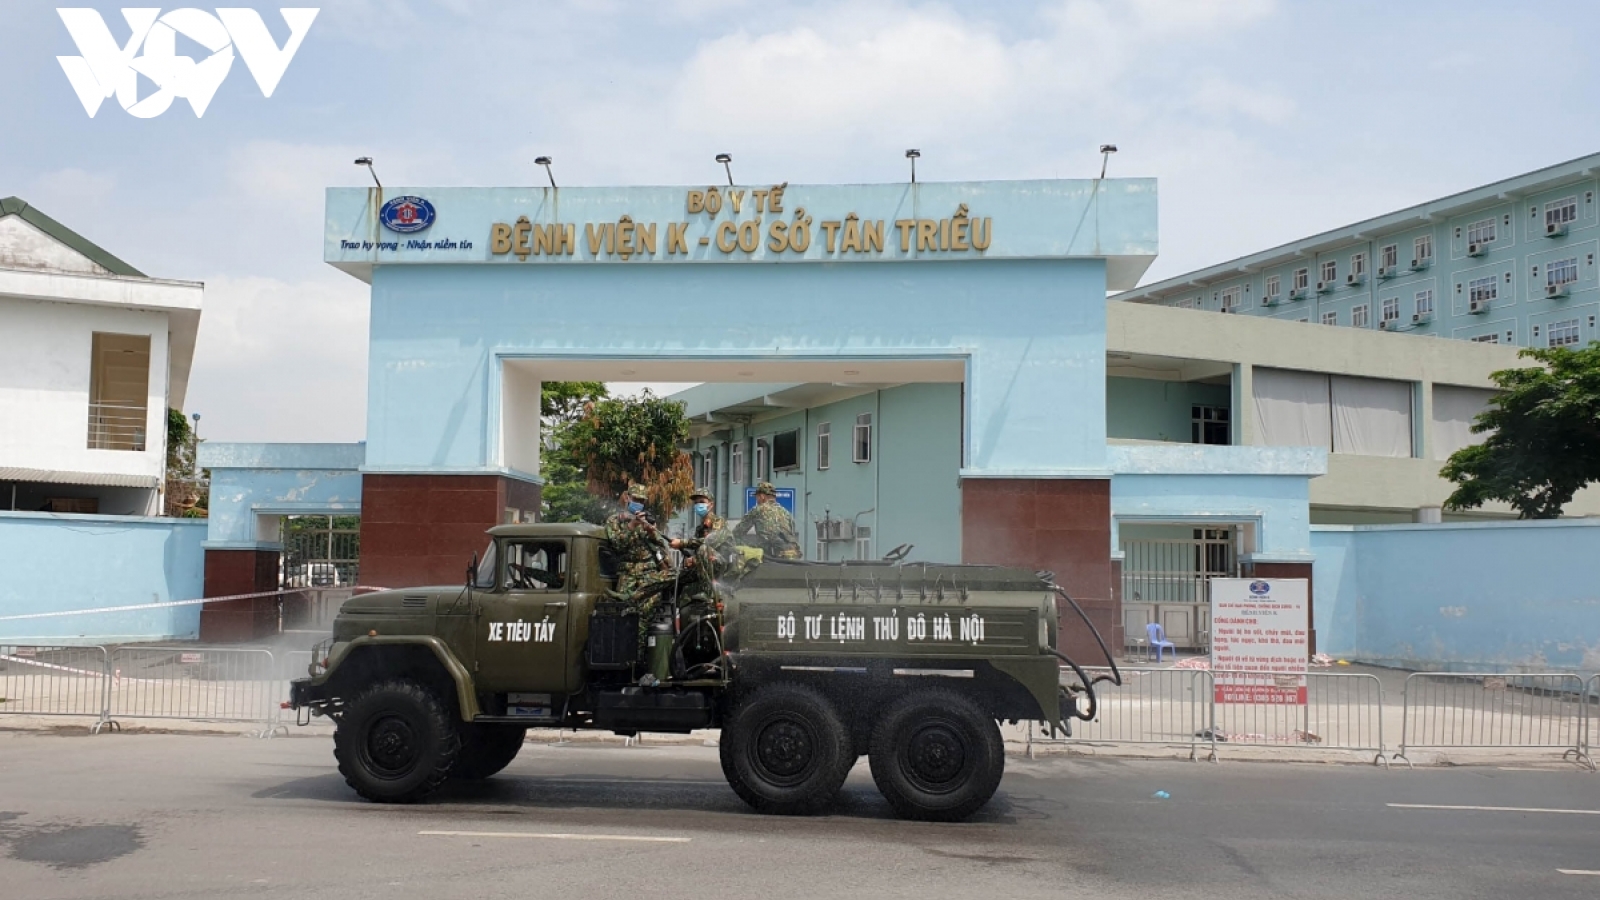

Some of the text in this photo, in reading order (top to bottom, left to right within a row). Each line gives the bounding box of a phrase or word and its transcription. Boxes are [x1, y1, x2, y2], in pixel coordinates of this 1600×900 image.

[687, 182, 788, 220] BỘ Y TẾ
[340, 240, 360, 249] Trao
[362, 240, 374, 251] hy
[376, 241, 399, 251] vọng
[406, 240, 432, 250] Nhận
[434, 237, 457, 249] niềm
[491, 215, 575, 261] BỆNH
[586, 214, 657, 261] VIỆN
[667, 222, 689, 255] K
[716, 215, 762, 253] CƠ
[768, 207, 812, 252] SỞ
[821, 212, 885, 252] TÂN
[895, 203, 992, 252] TRIỀU
[488, 615, 557, 642] XE TIÊU TẨY
[777, 608, 985, 645] BỘ TƯ LỆNH THỦ ĐÔ HÀ NỘI
